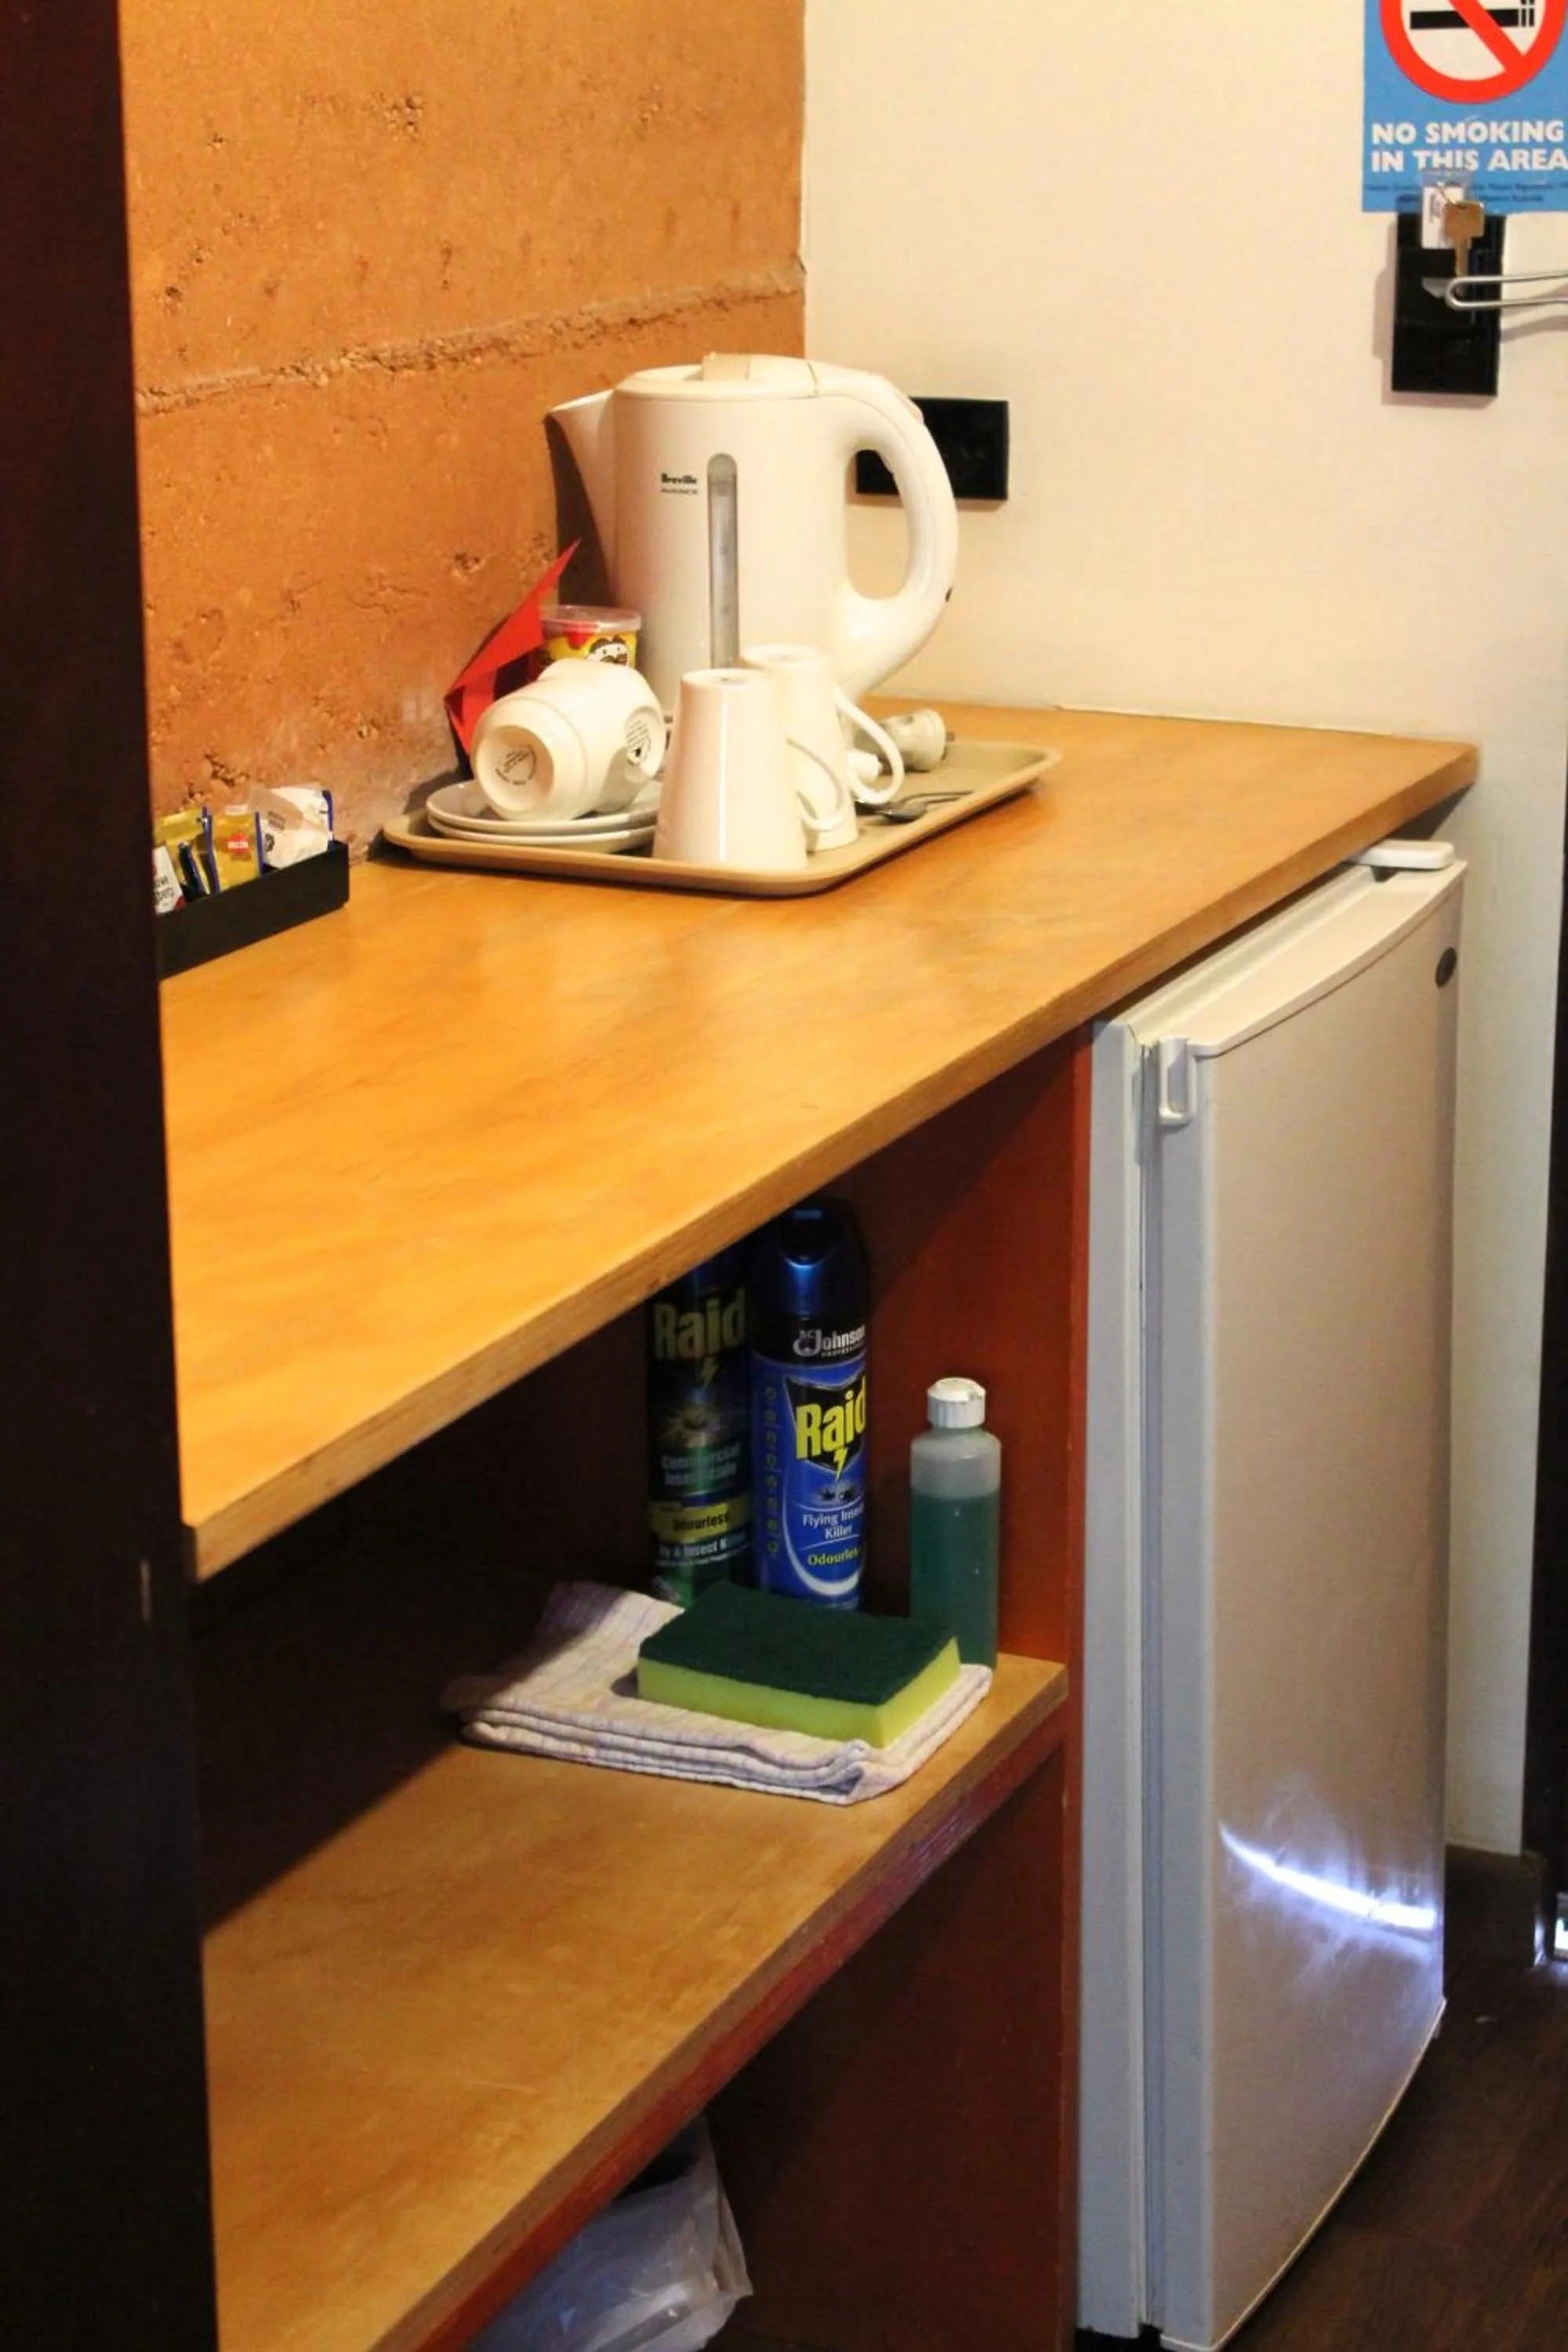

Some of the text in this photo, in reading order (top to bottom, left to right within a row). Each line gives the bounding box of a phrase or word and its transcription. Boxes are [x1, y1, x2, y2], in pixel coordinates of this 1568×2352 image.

[1372, 120, 1564, 145] NO SMOKING
[1370, 147, 1568, 172] IN THIS AREA
[654, 1287, 746, 1360] Raid
[795, 1375, 866, 1461] Raid
[802, 1512, 839, 1529] Flying
[825, 1524, 853, 1540] Killer
